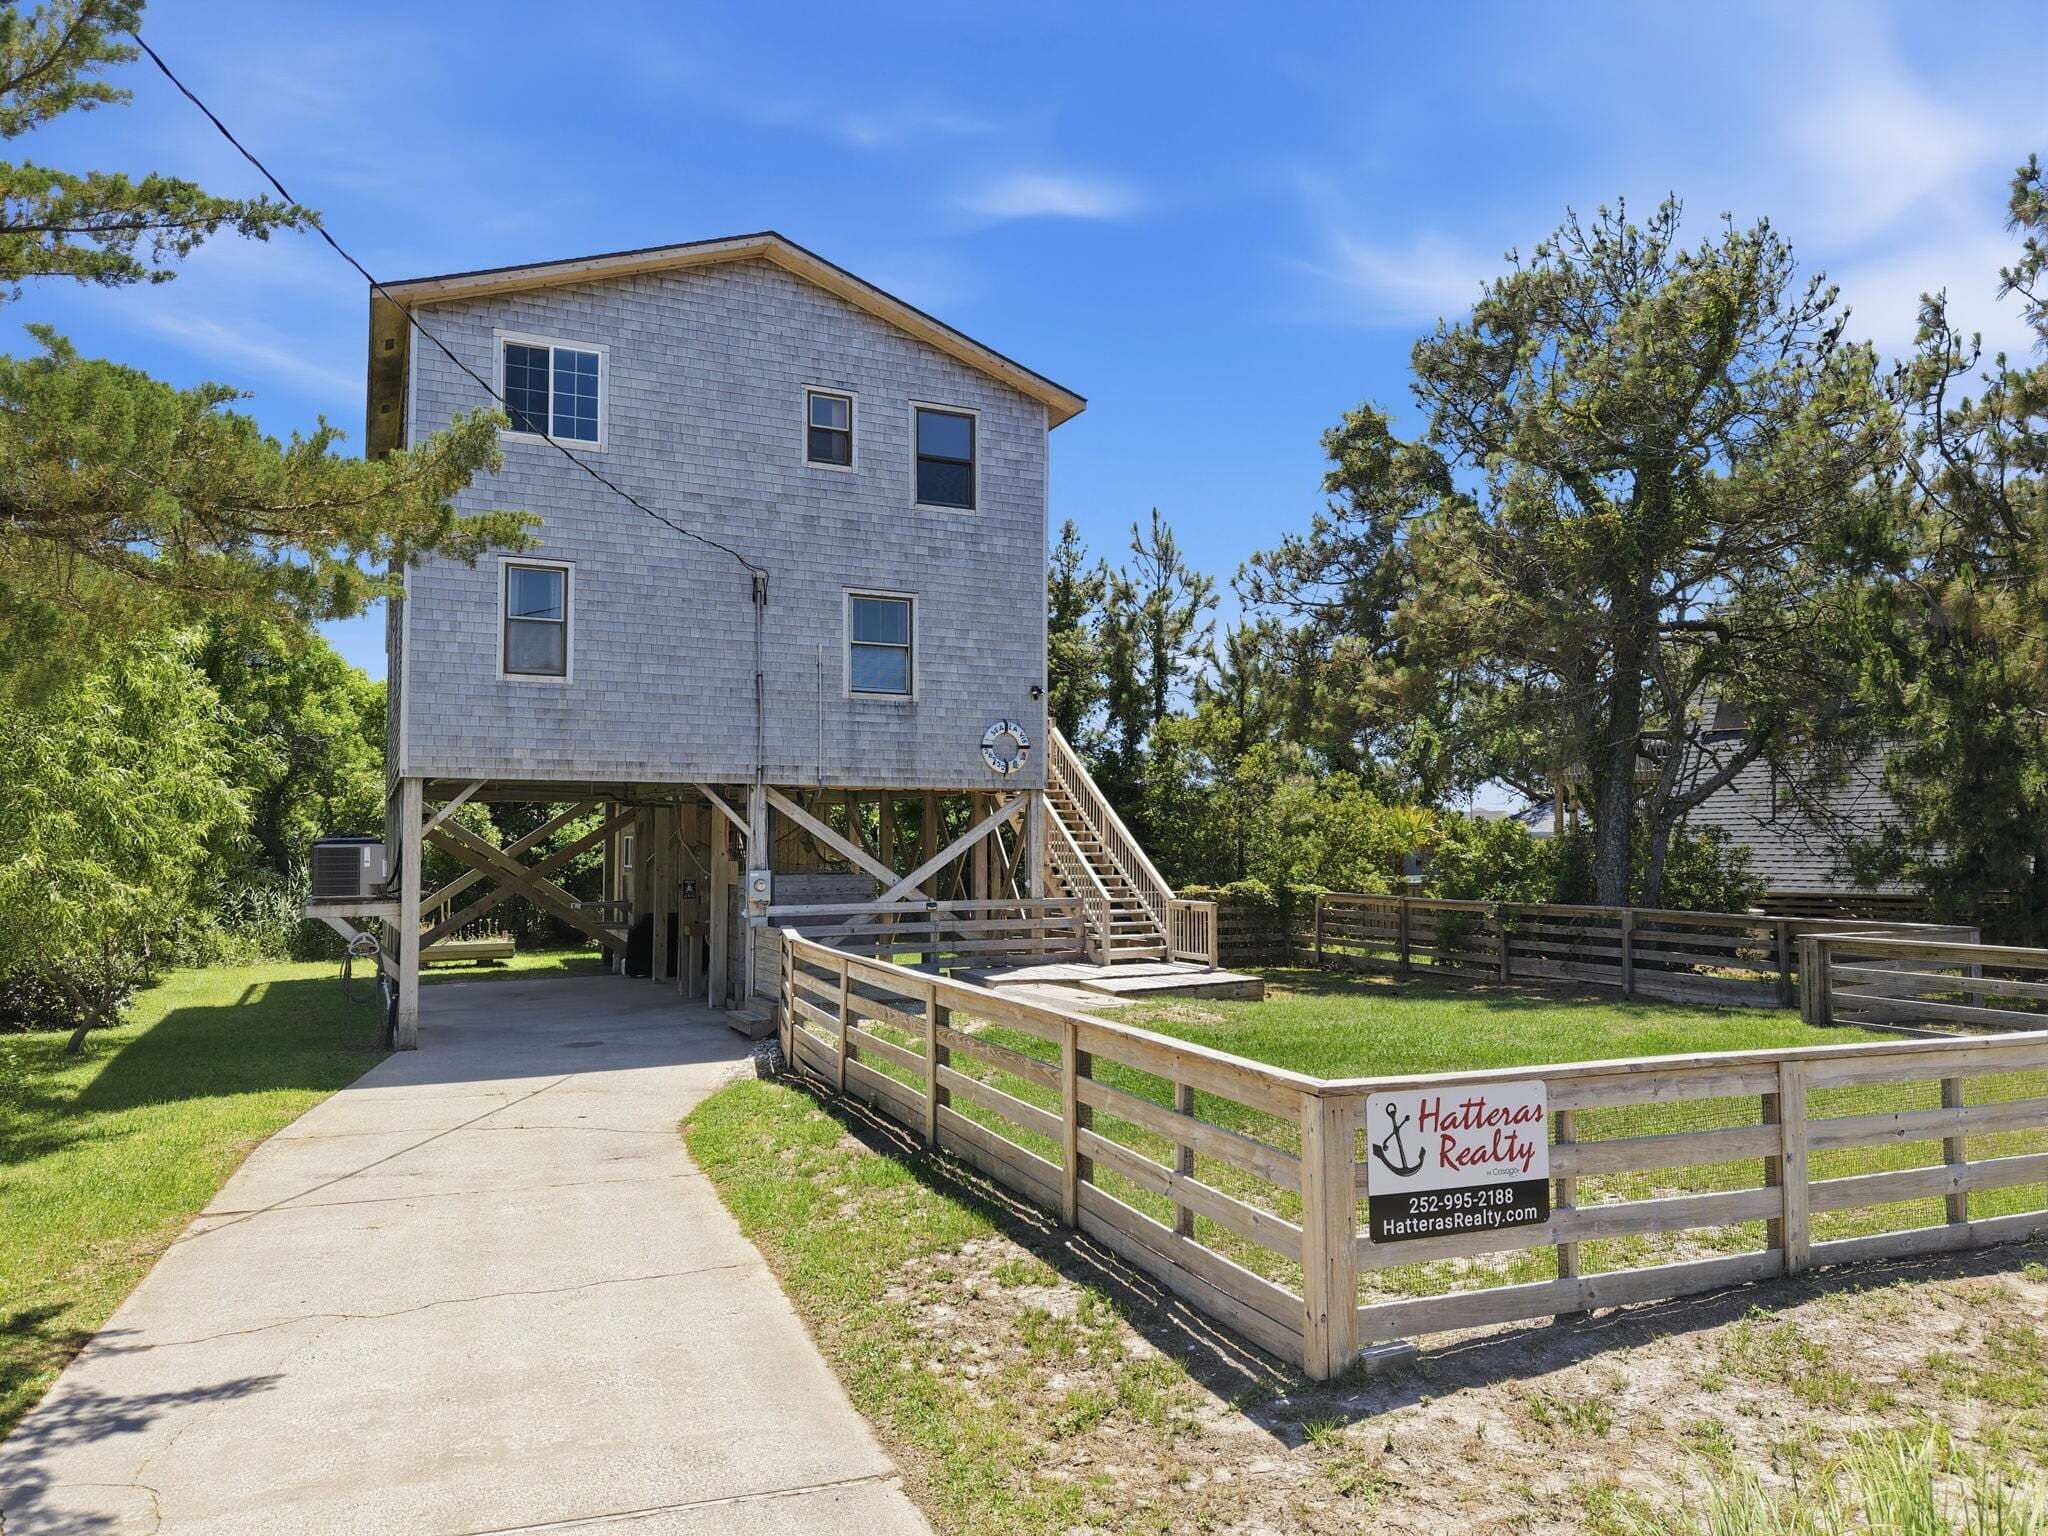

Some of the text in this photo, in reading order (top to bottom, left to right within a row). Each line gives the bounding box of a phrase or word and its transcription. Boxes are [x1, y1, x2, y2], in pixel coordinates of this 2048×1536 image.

[1418, 1097, 1544, 1133] Hatteras
[1440, 1128, 1535, 1173] Realty
[1409, 1188, 1513, 1214] 252-995-2188
[1383, 1206, 1537, 1236] HatterasRealty.com
